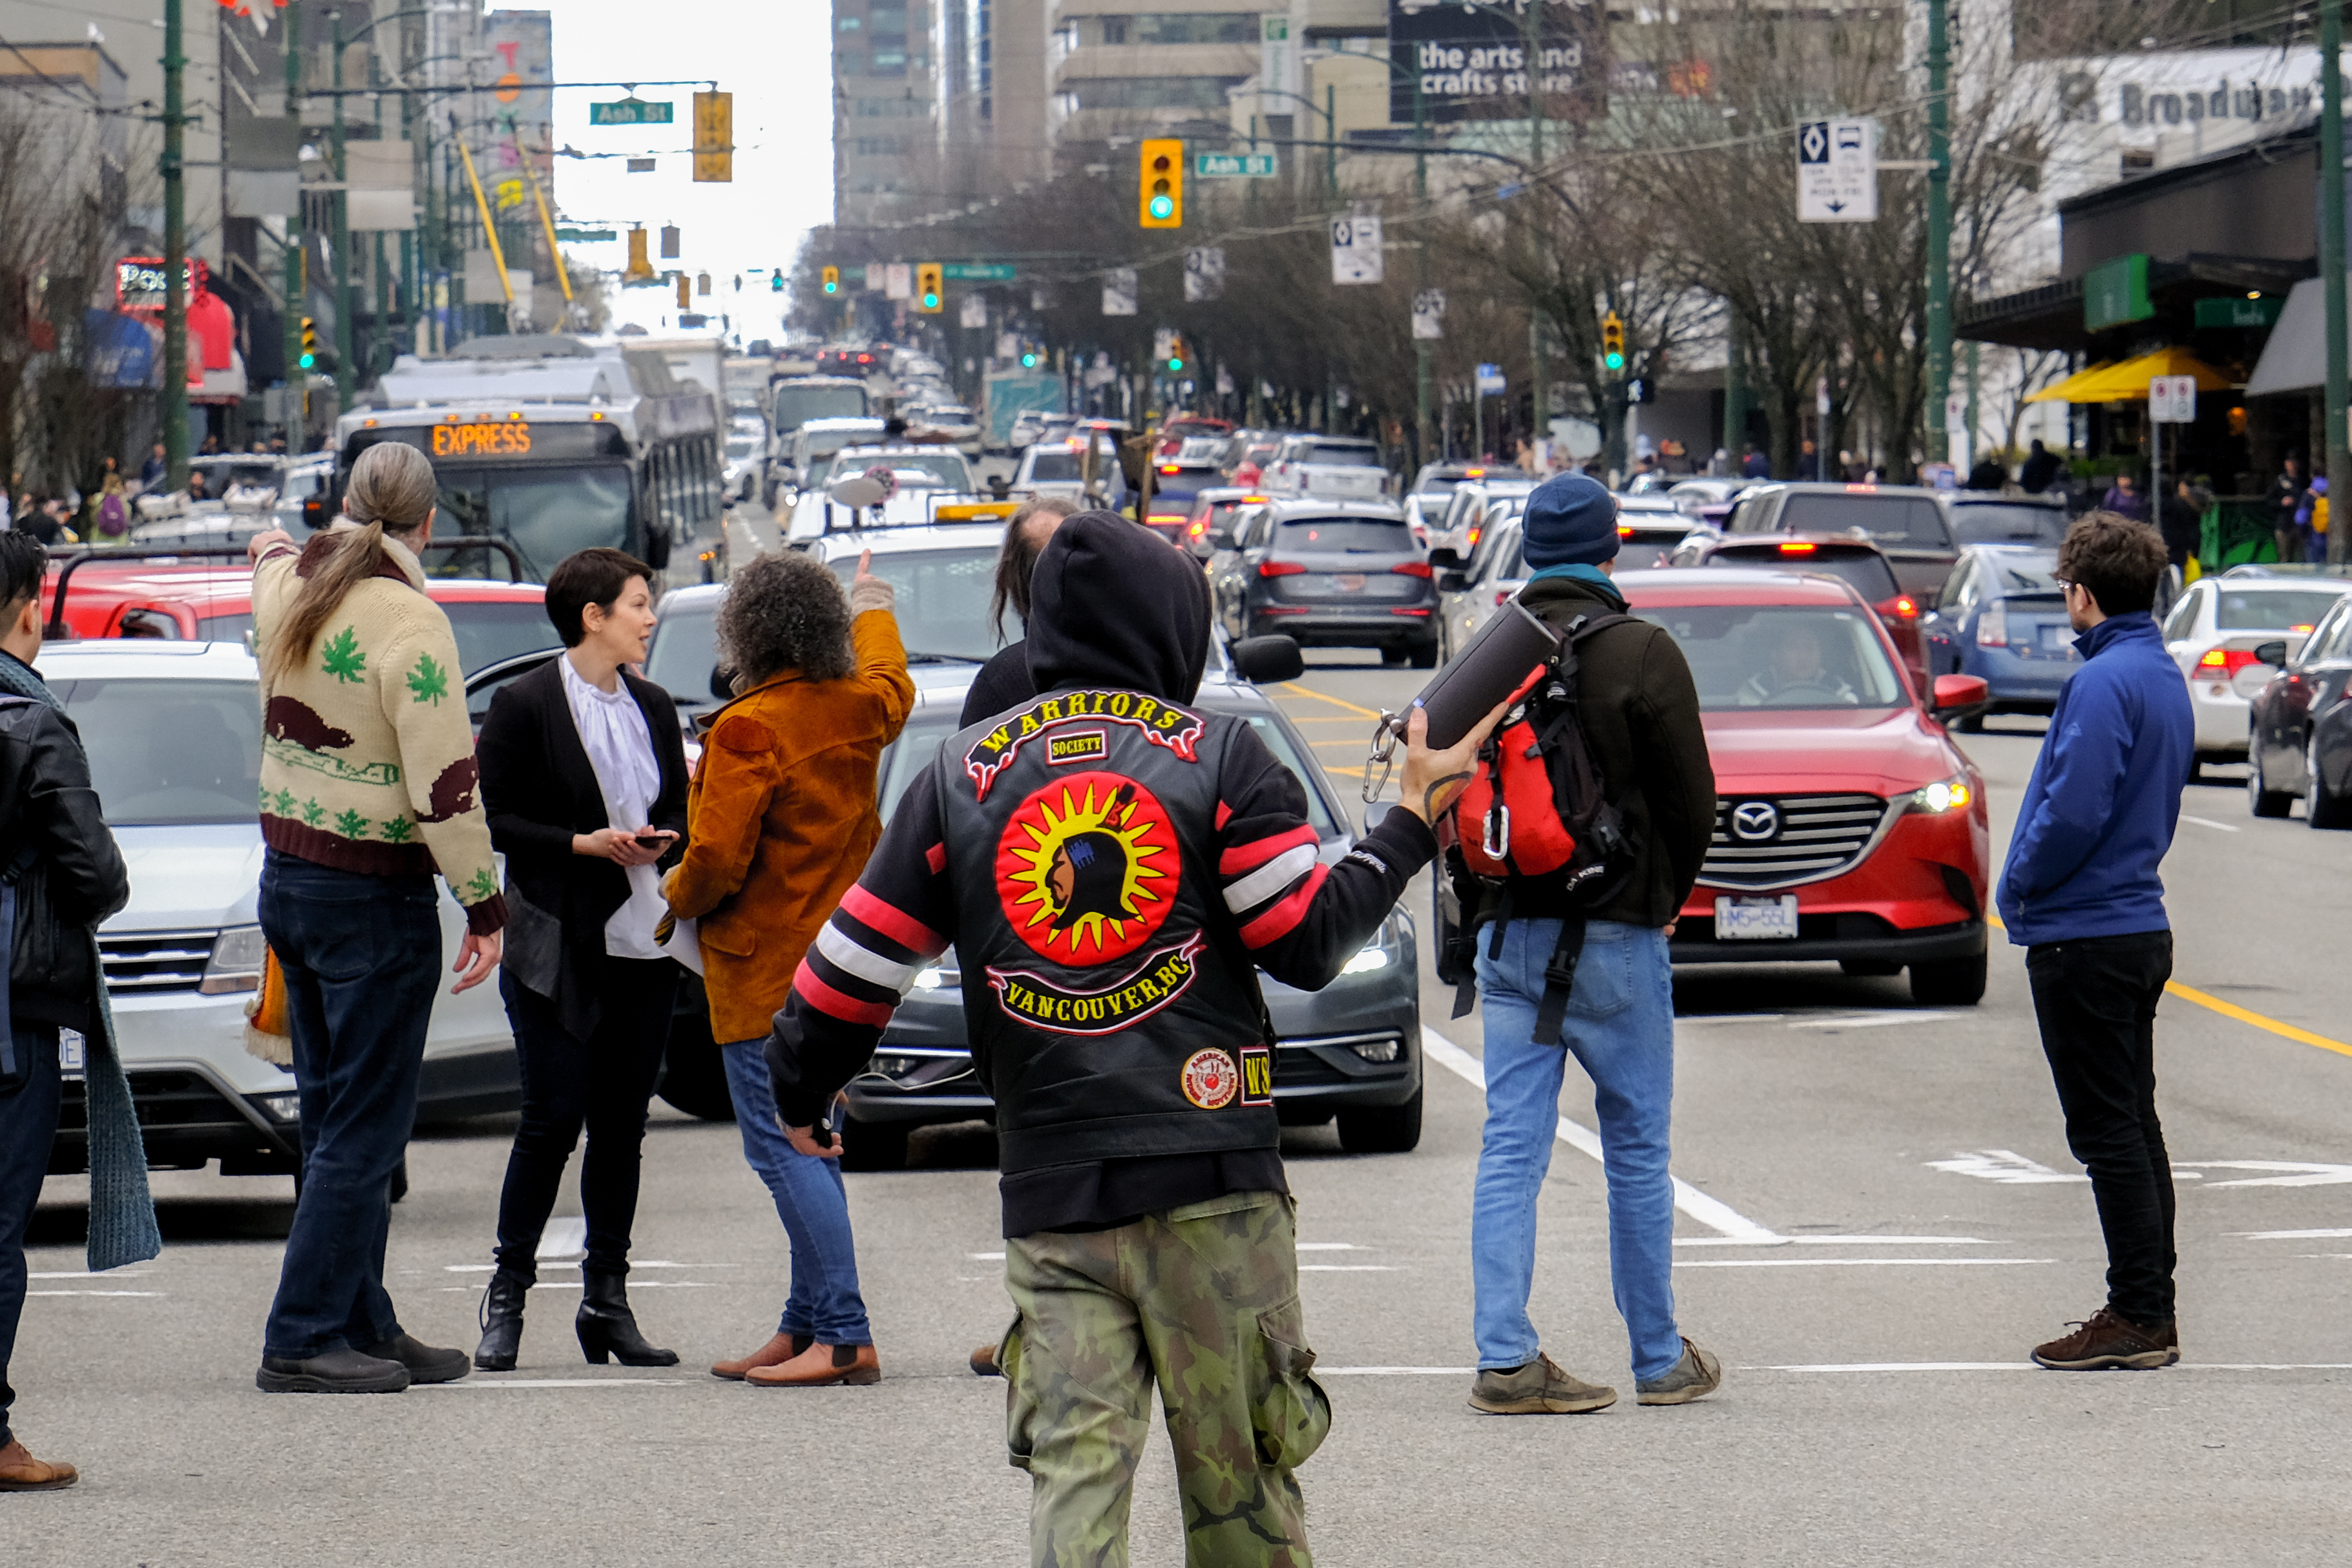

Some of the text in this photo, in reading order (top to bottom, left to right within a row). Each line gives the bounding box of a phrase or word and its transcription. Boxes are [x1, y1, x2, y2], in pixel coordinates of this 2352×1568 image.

[1420, 41, 1465, 69] the
[1469, 45, 1524, 69] arts
[1420, 68, 1498, 95] crafts
[598, 105, 666, 123] Ash St
[1205, 157, 1266, 174] Ash St
[432, 423, 531, 456] EXPRESS
[981, 692, 1184, 753] WARRIORS
[1052, 736, 1102, 757] SOCIETY
[1244, 1056, 1271, 1096] WS
